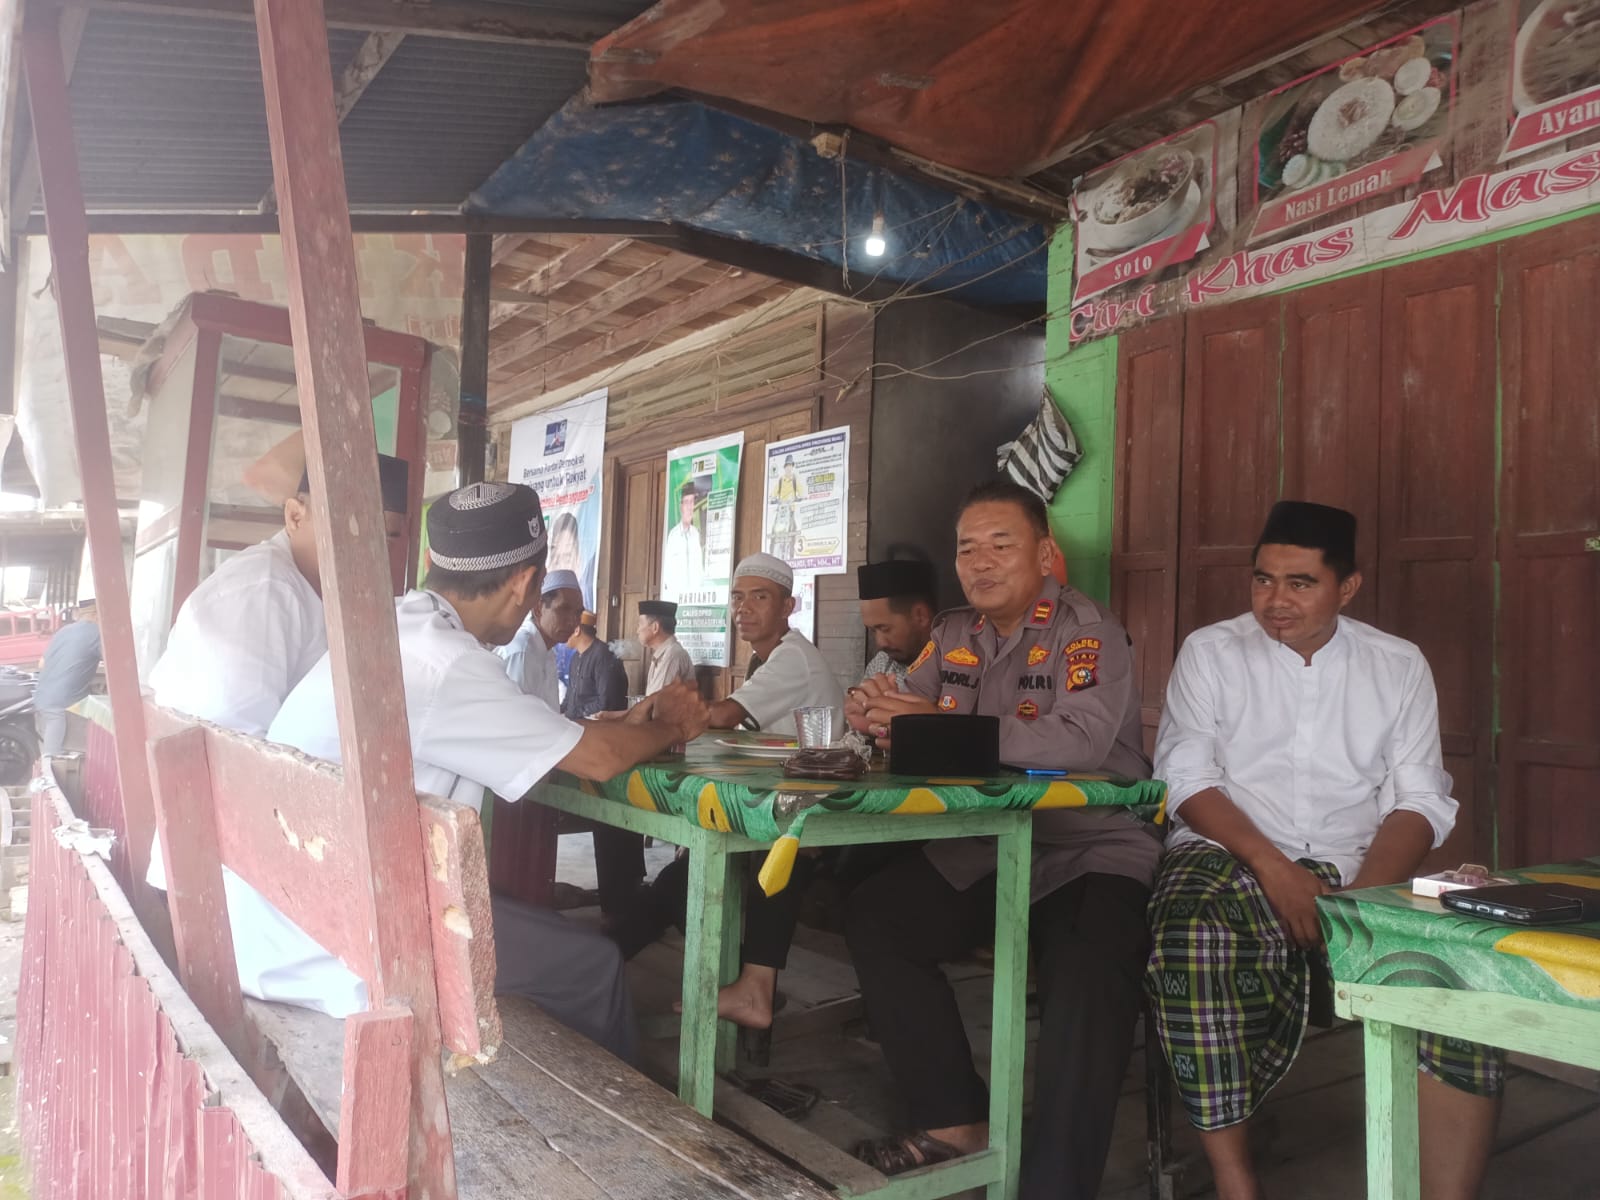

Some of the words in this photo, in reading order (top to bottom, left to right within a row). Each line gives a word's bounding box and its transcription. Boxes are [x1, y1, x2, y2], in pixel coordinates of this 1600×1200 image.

[1285, 195, 1320, 222] Nasi
[1327, 169, 1393, 207] Lemak
[1069, 282, 1156, 342] Ciri
[1182, 226, 1354, 304] Khas
[798, 538, 804, 552] 3
[678, 591, 717, 604] HARIANTO
[1018, 674, 1053, 690] POLRI
